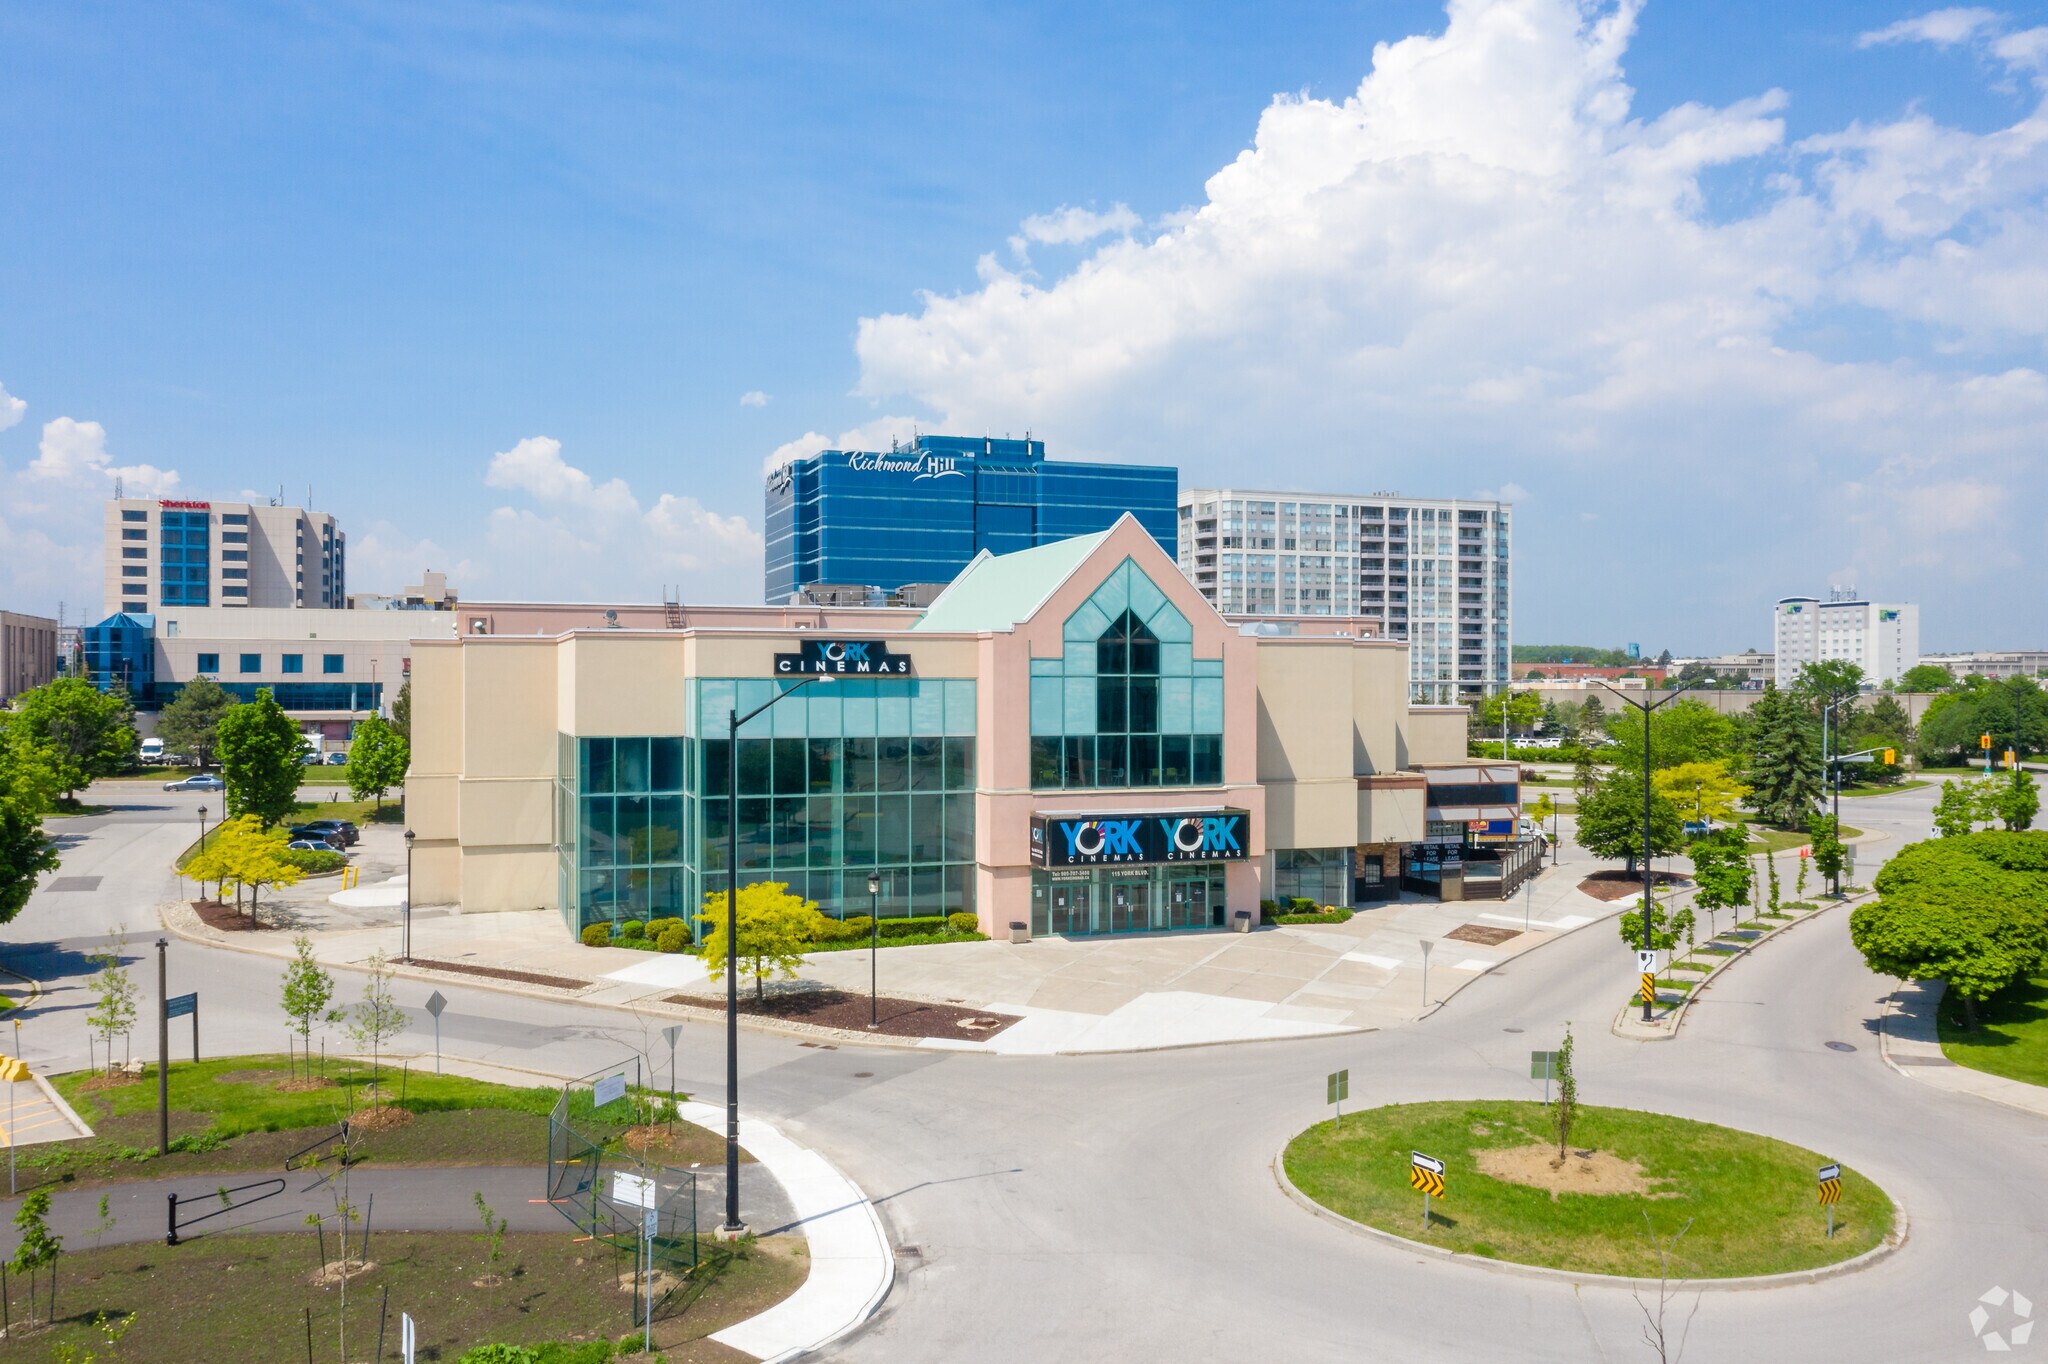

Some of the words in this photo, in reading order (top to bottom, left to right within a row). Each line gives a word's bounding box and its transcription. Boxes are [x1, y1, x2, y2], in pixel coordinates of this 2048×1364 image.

[842, 450, 932, 473] Richmond
[927, 456, 955, 474] Hill
[159, 500, 209, 509] Sheraton
[817, 642, 870, 661] YORK
[779, 660, 907, 672] CINEMAS
[1060, 820, 1143, 855] YORK
[1160, 817, 1241, 852] YORK
[1068, 854, 1144, 862] CINEMAS
[1167, 849, 1241, 860] CINEMAS
